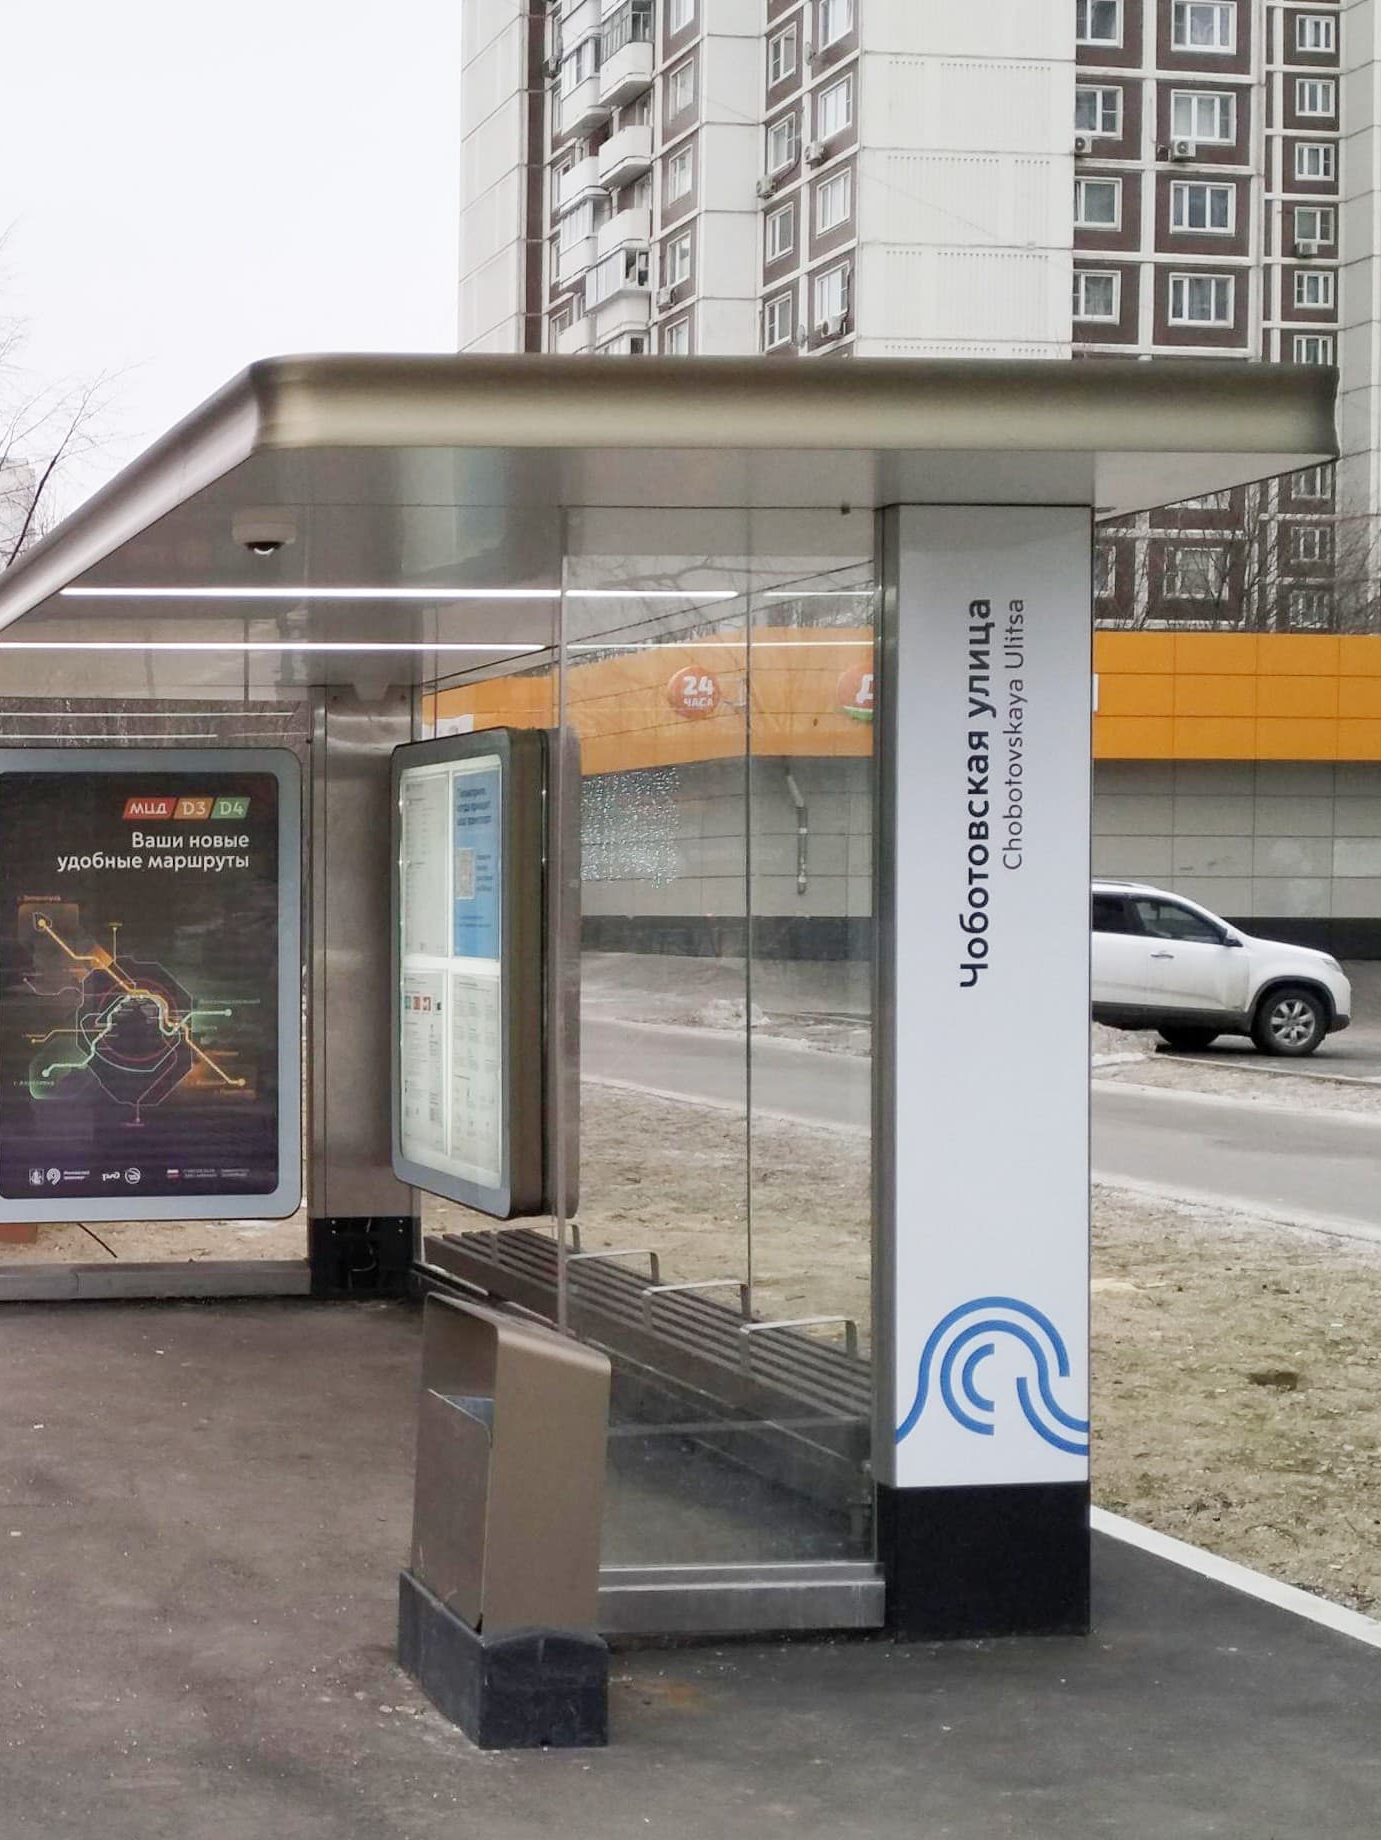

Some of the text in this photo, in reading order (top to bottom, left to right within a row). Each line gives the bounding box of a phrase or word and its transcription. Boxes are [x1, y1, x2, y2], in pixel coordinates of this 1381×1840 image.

[683, 675, 713, 696] 24
[1002, 598, 1029, 870] Chobotovskaya Ulitsa
[959, 599, 997, 988] Чоботовская улица
[130, 802, 245, 816] МЦД D3 D4
[132, 832, 249, 848] Ваши новые
[57, 852, 249, 872] удобные маршруты
